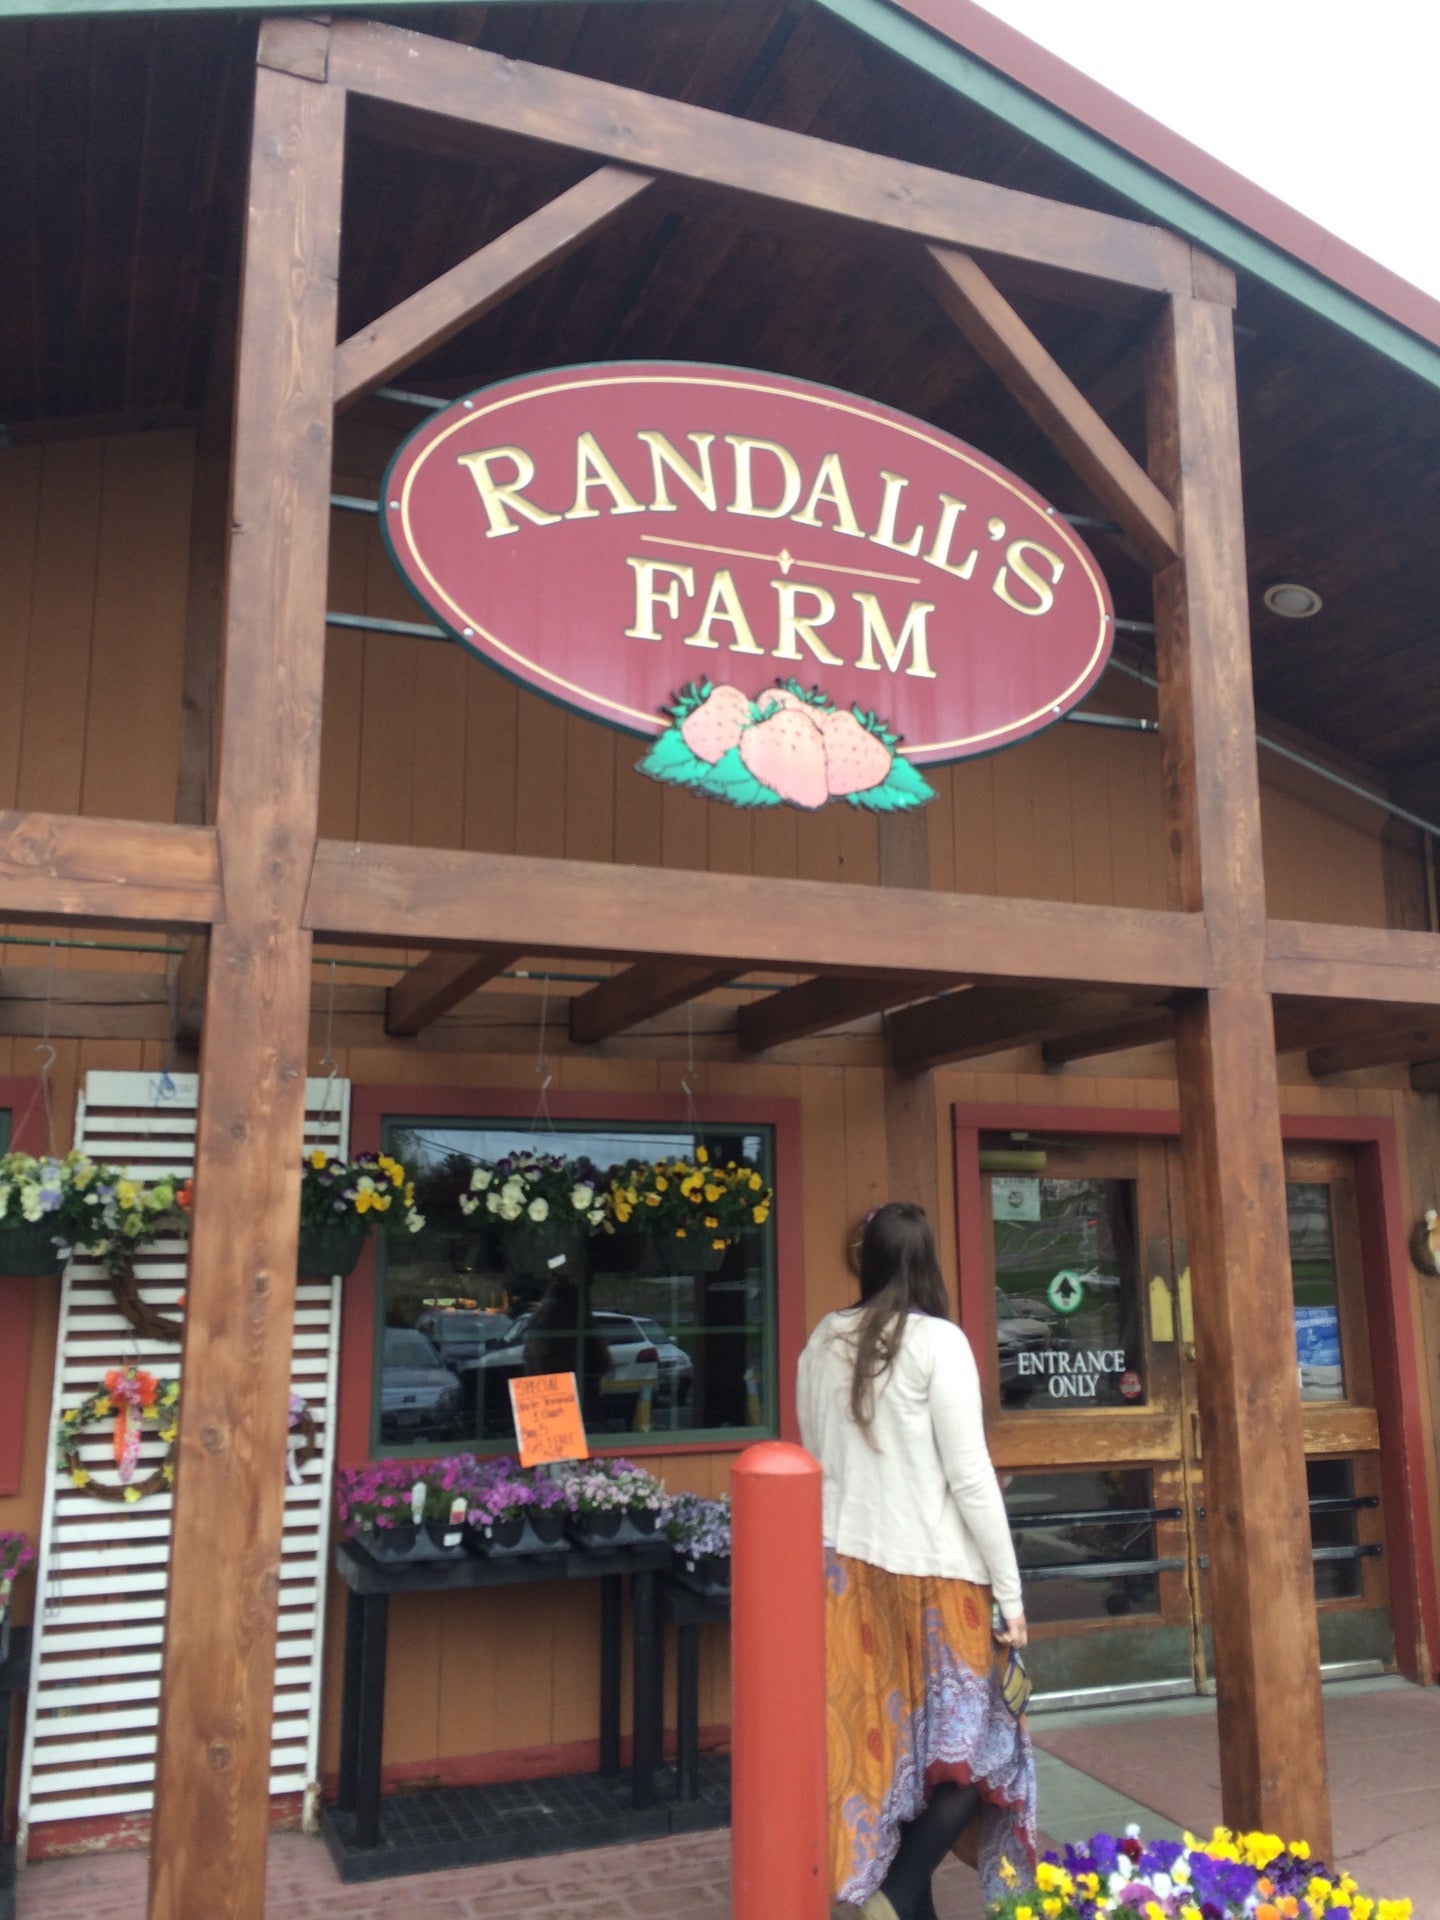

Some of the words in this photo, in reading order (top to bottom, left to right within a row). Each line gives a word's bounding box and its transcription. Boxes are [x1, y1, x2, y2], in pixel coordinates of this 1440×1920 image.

[457, 430, 1065, 617] RANDALL'S
[625, 556, 936, 678] FARM
[1017, 1349, 1127, 1376] ENTRANCE
[1048, 1374, 1099, 1398] ONLY
